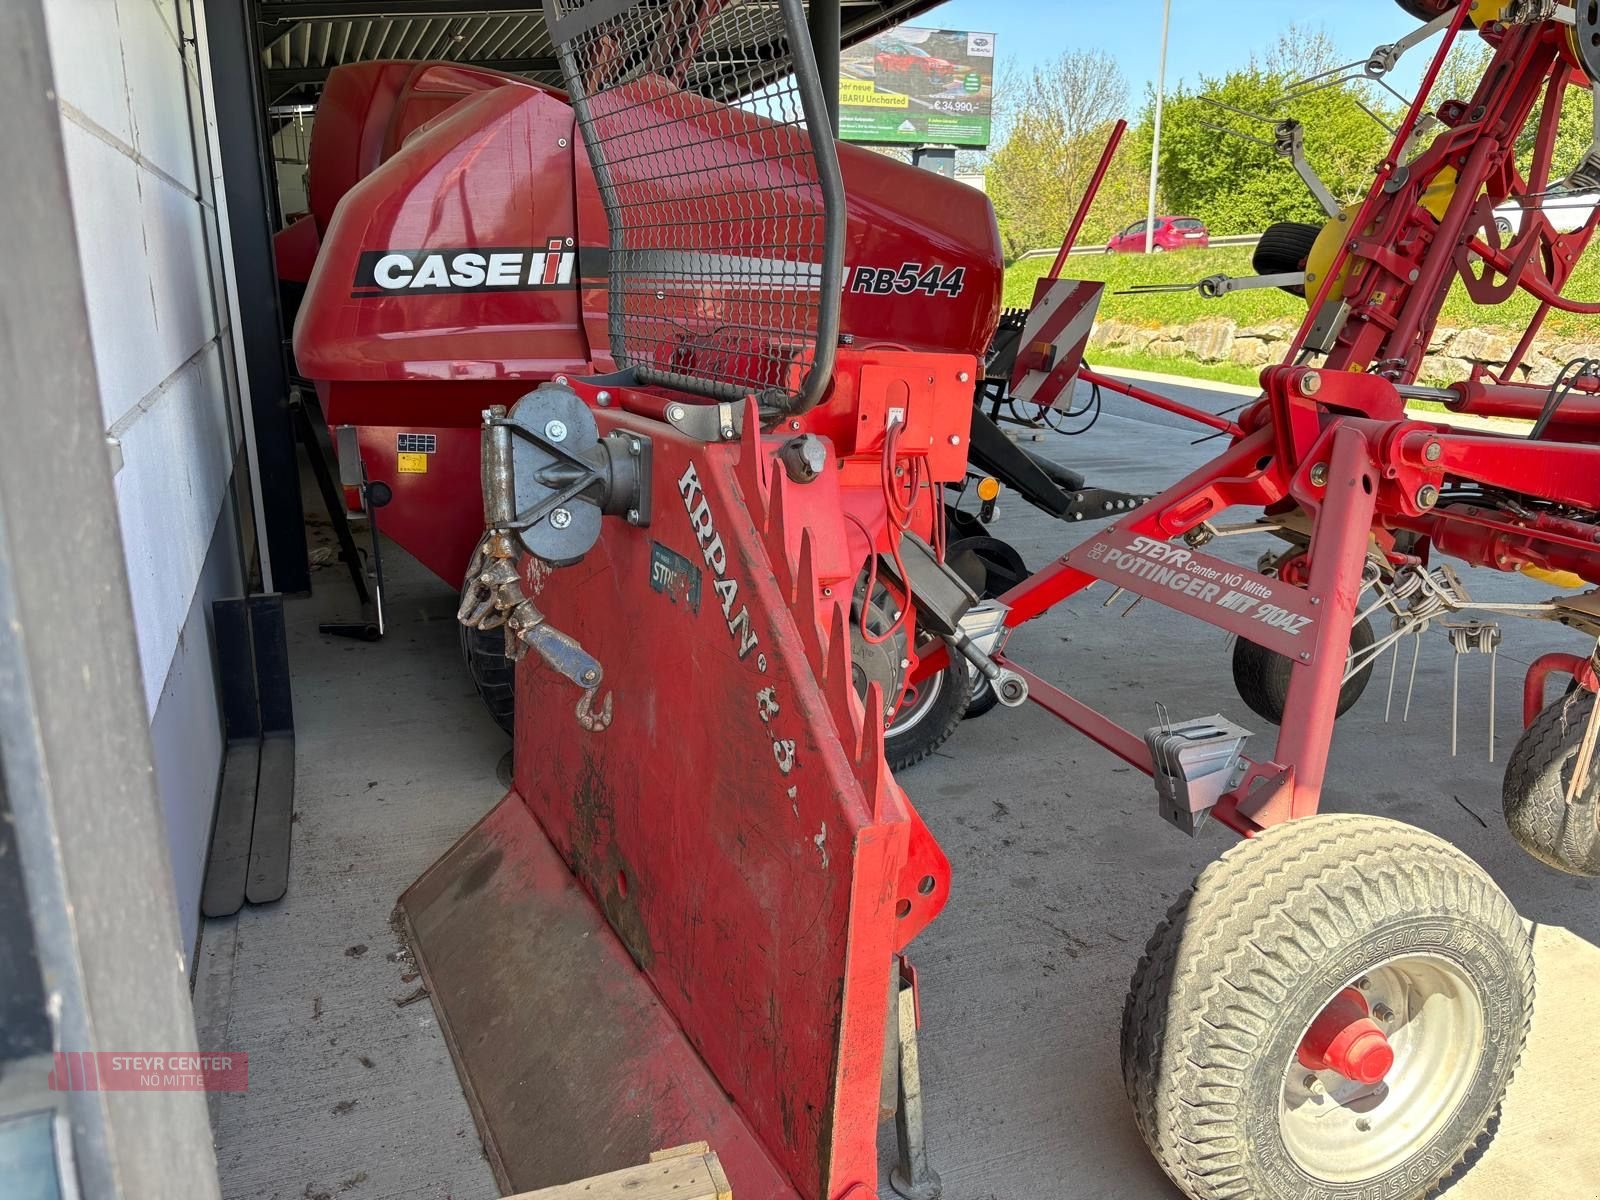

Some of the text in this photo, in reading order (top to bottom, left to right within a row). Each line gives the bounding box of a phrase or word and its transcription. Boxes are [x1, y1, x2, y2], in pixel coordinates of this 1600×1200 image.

[839, 94, 906, 105] BARU Uncharted
[373, 252, 525, 289] CASE
[851, 262, 965, 297] RB544
[677, 458, 759, 659] KRPAN
[1125, 536, 1192, 568] STEYR
[1185, 560, 1222, 580] Center
[1241, 580, 1273, 599] Mitte
[1216, 590, 1260, 614] HIT
[1251, 603, 1314, 635] 910AZ
